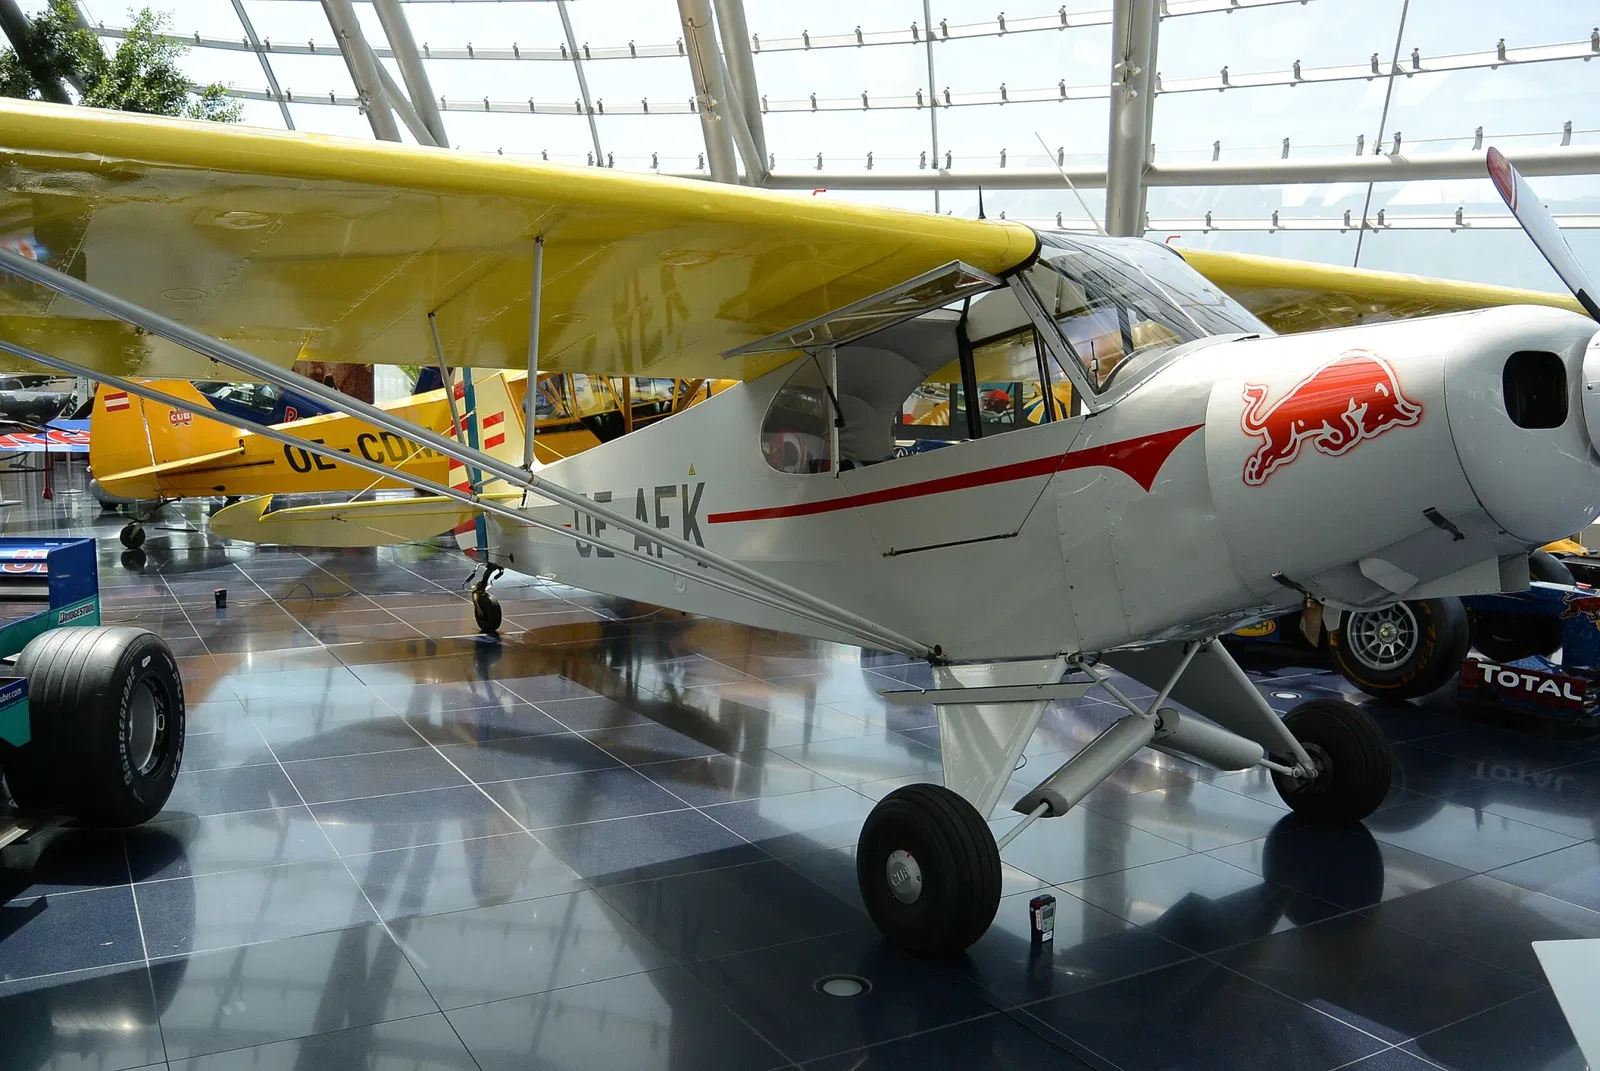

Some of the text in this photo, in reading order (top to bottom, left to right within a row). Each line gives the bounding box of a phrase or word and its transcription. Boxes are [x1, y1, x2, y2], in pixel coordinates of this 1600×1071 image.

[170, 412, 192, 421] CUB
[574, 482, 708, 568] OEAFK
[59, 602, 95, 624] BRIDGESTONE
[1477, 663, 1582, 702] TOTAL
[892, 866, 911, 887] CUB
